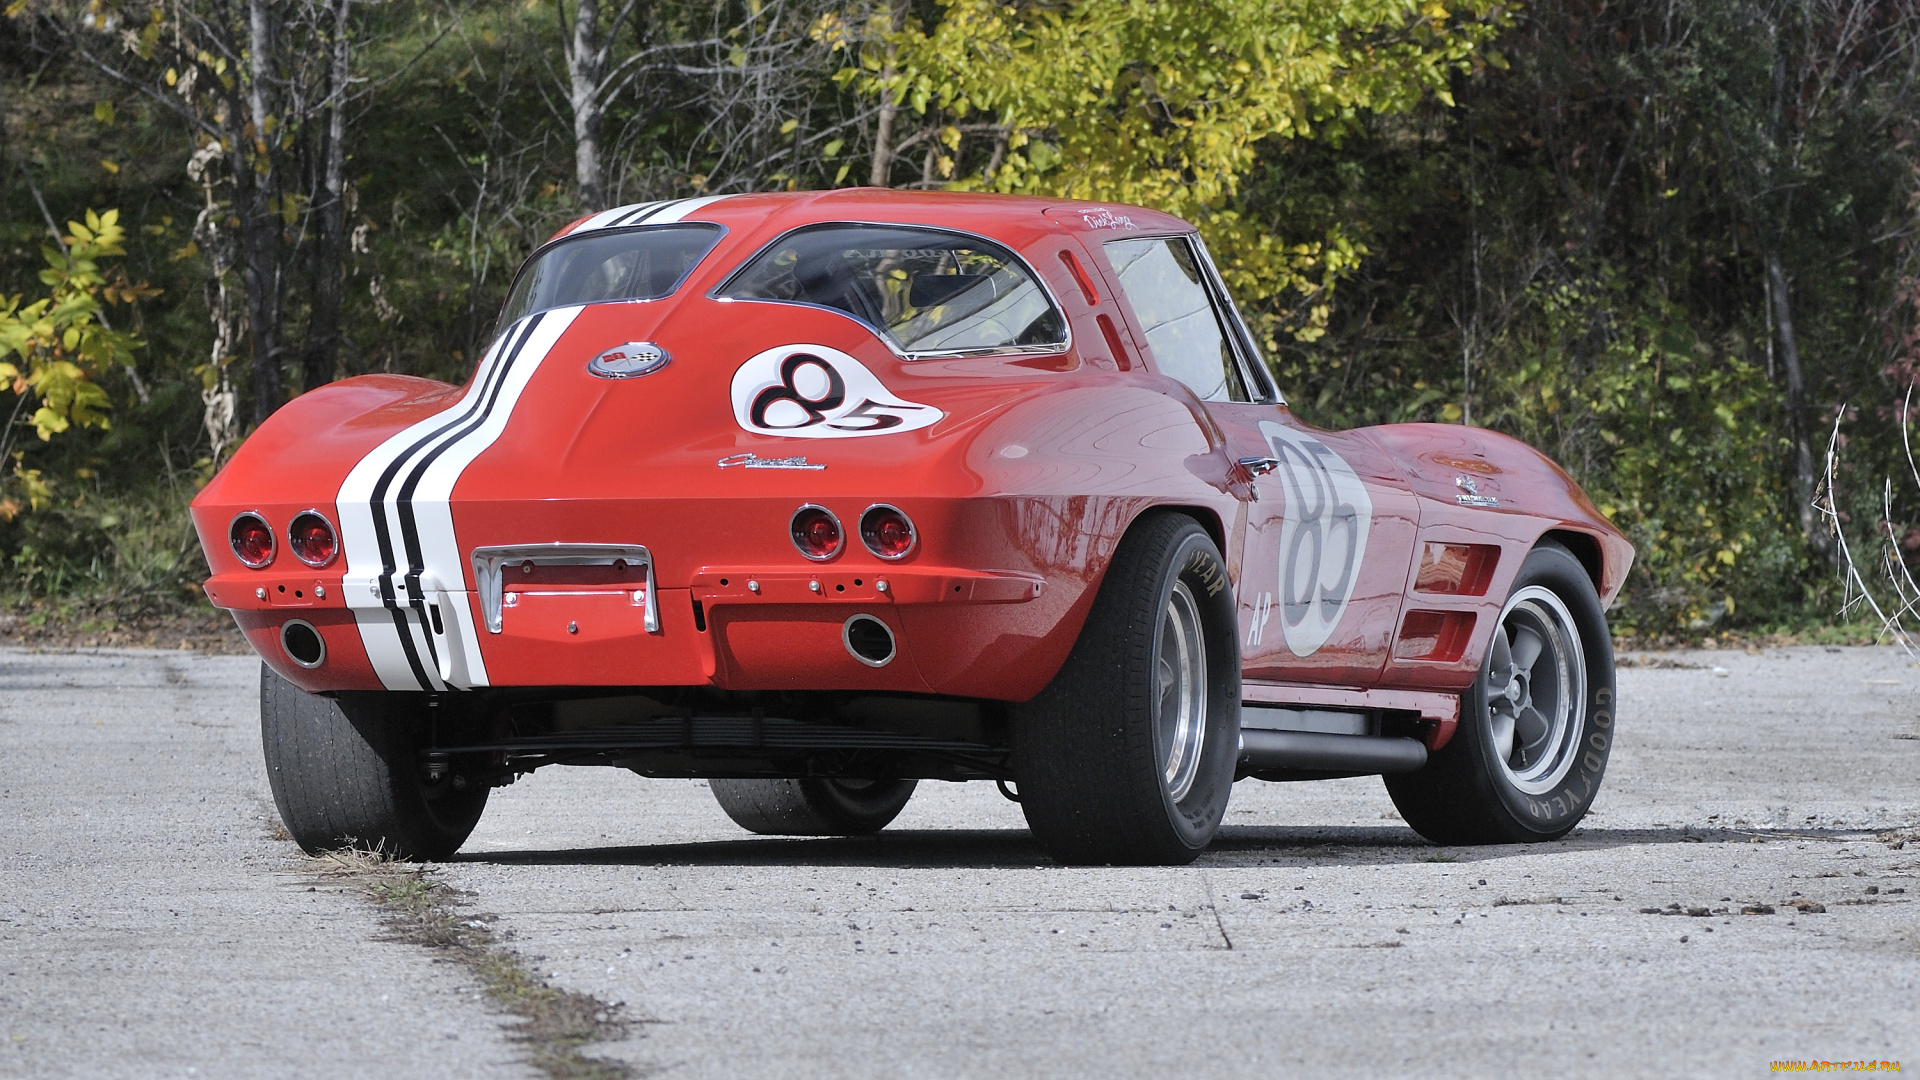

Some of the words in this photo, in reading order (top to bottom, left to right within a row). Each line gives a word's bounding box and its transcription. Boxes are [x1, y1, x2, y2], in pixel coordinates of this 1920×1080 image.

[746, 351, 926, 431] 85
[1272, 435, 1358, 628] 85
[1246, 592, 1271, 646] AP
